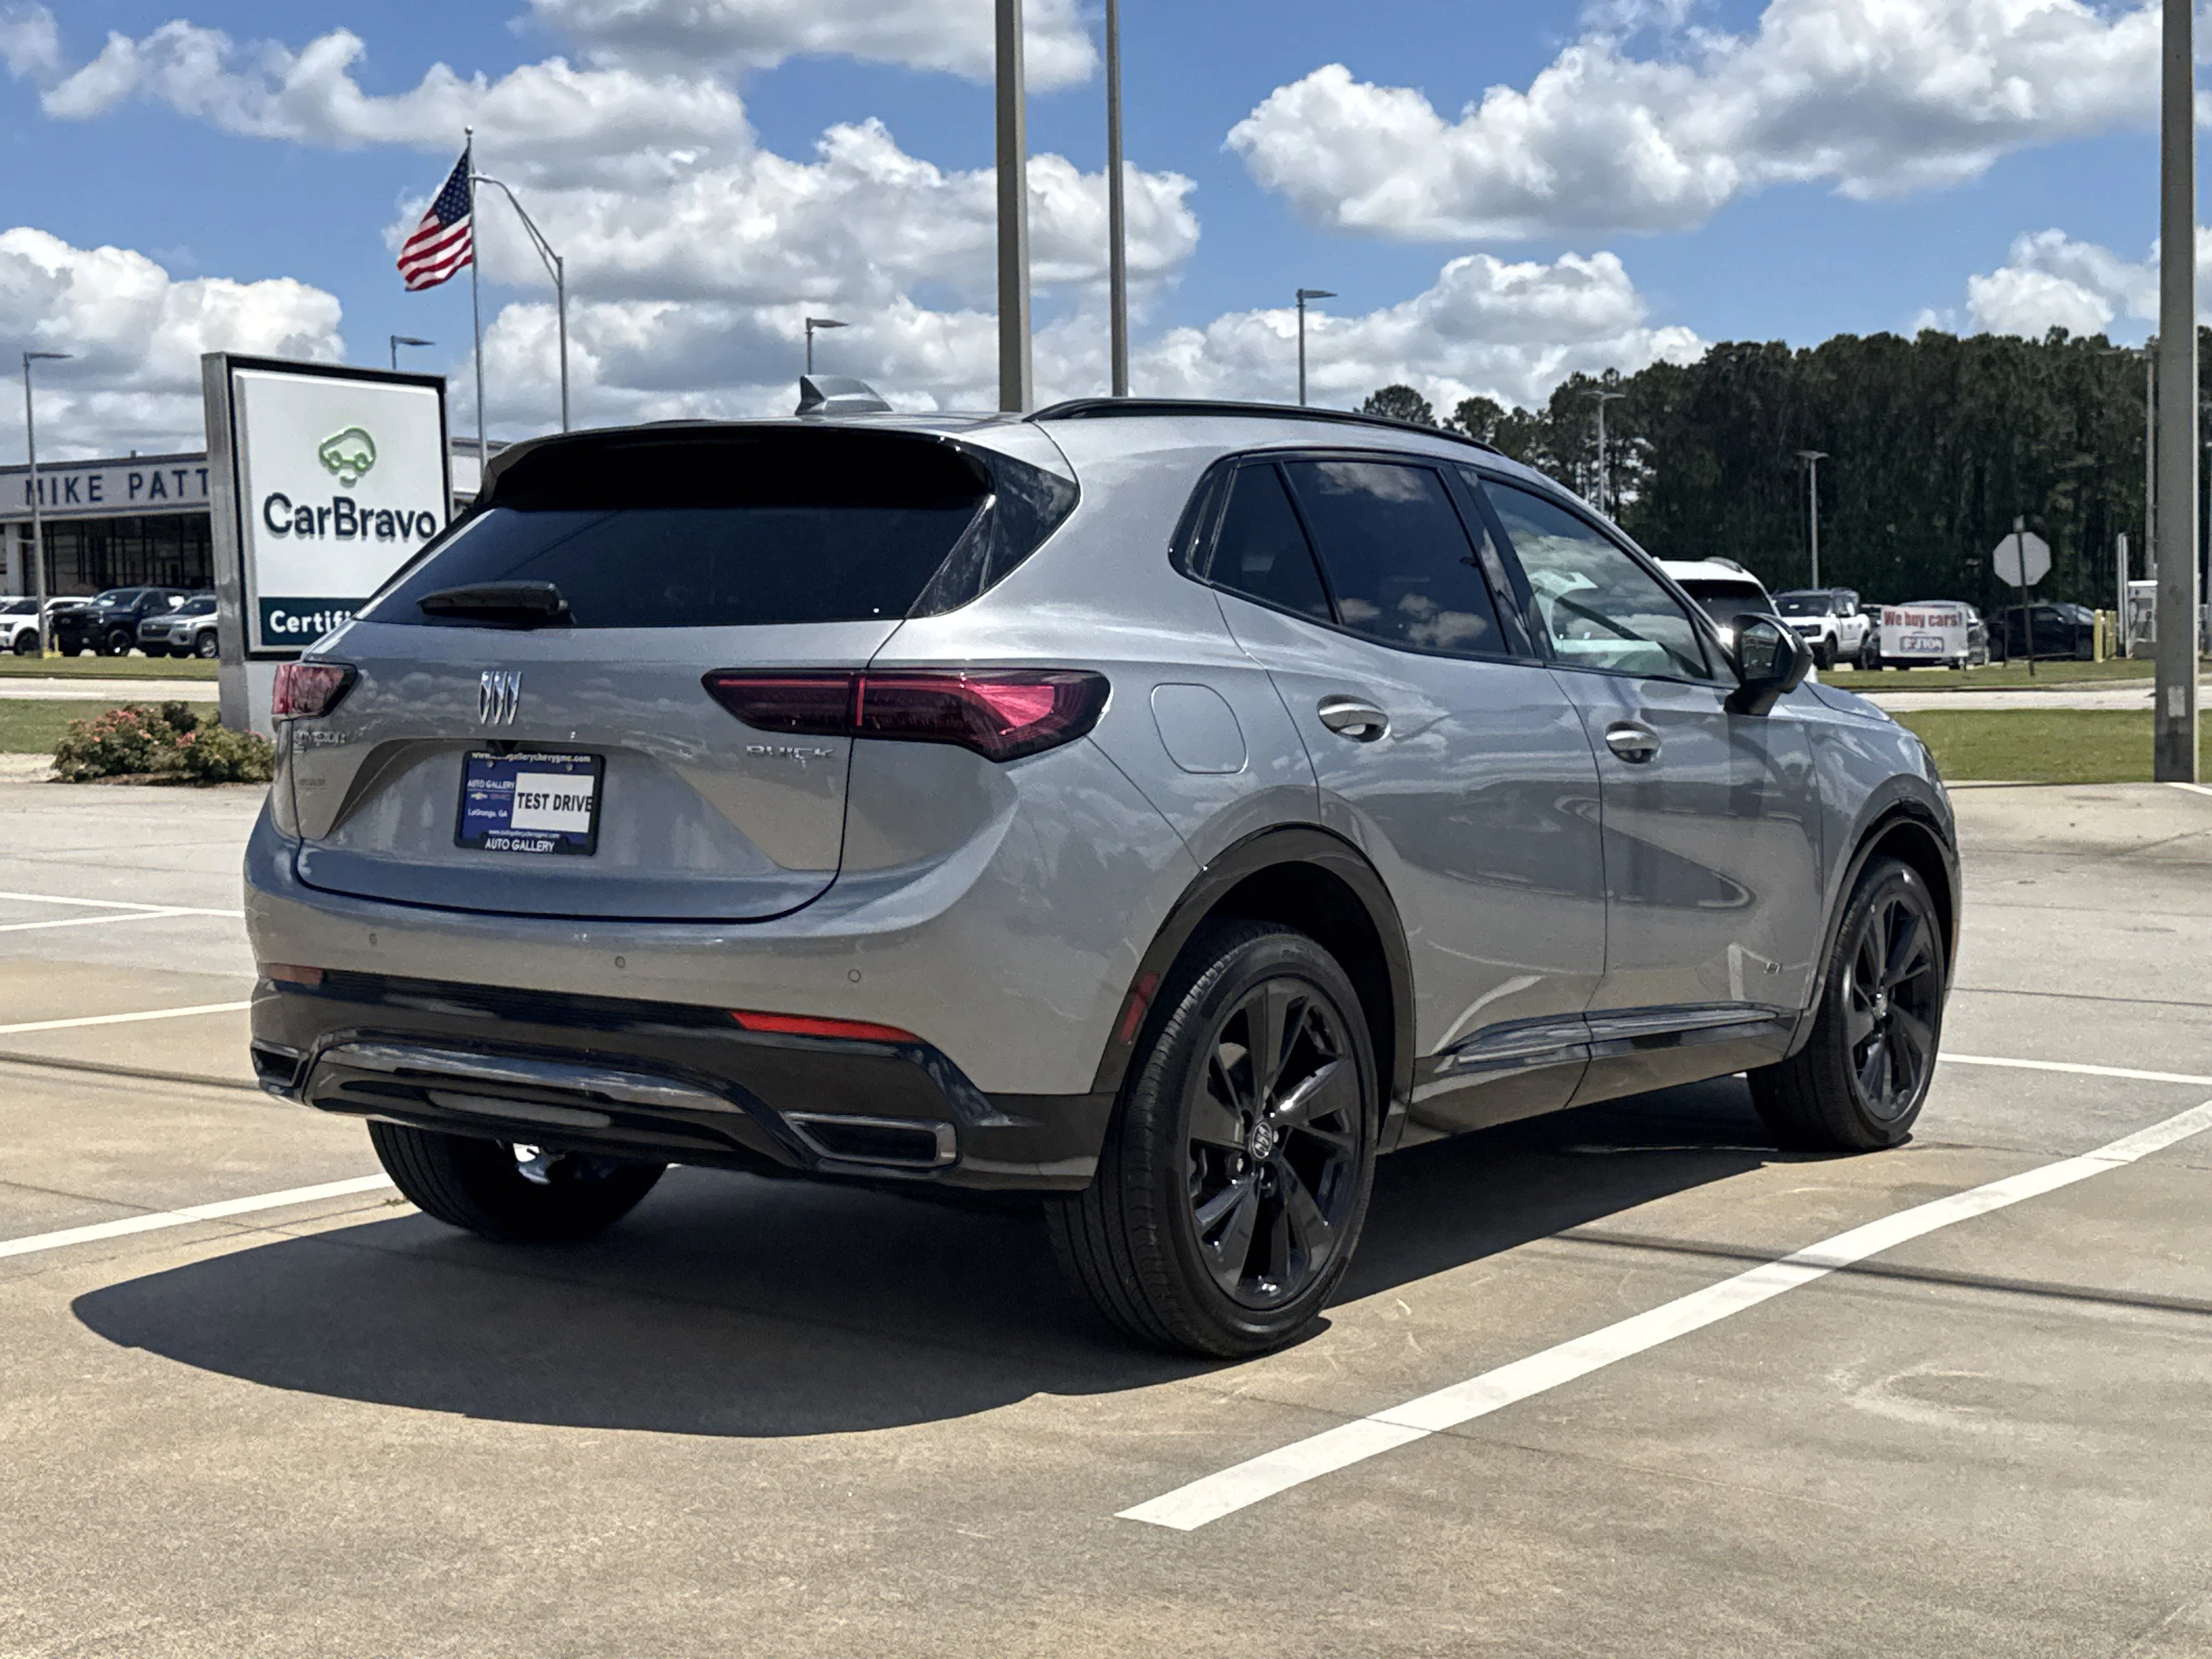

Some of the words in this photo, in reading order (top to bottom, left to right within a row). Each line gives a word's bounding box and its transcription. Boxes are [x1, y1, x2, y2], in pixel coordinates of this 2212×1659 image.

[25, 474, 103, 505] MIKE
[263, 491, 437, 539] CarBravo
[1884, 610, 1902, 626] We
[1904, 610, 1925, 628] buy
[1928, 610, 1962, 627] cars!
[467, 778, 485, 788] AUTO
[486, 780, 516, 789] GALLERY
[517, 792, 550, 810] TEST
[553, 793, 593, 812] DRIVE
[484, 837, 510, 850] AUTO
[511, 838, 556, 852] GALLERY
